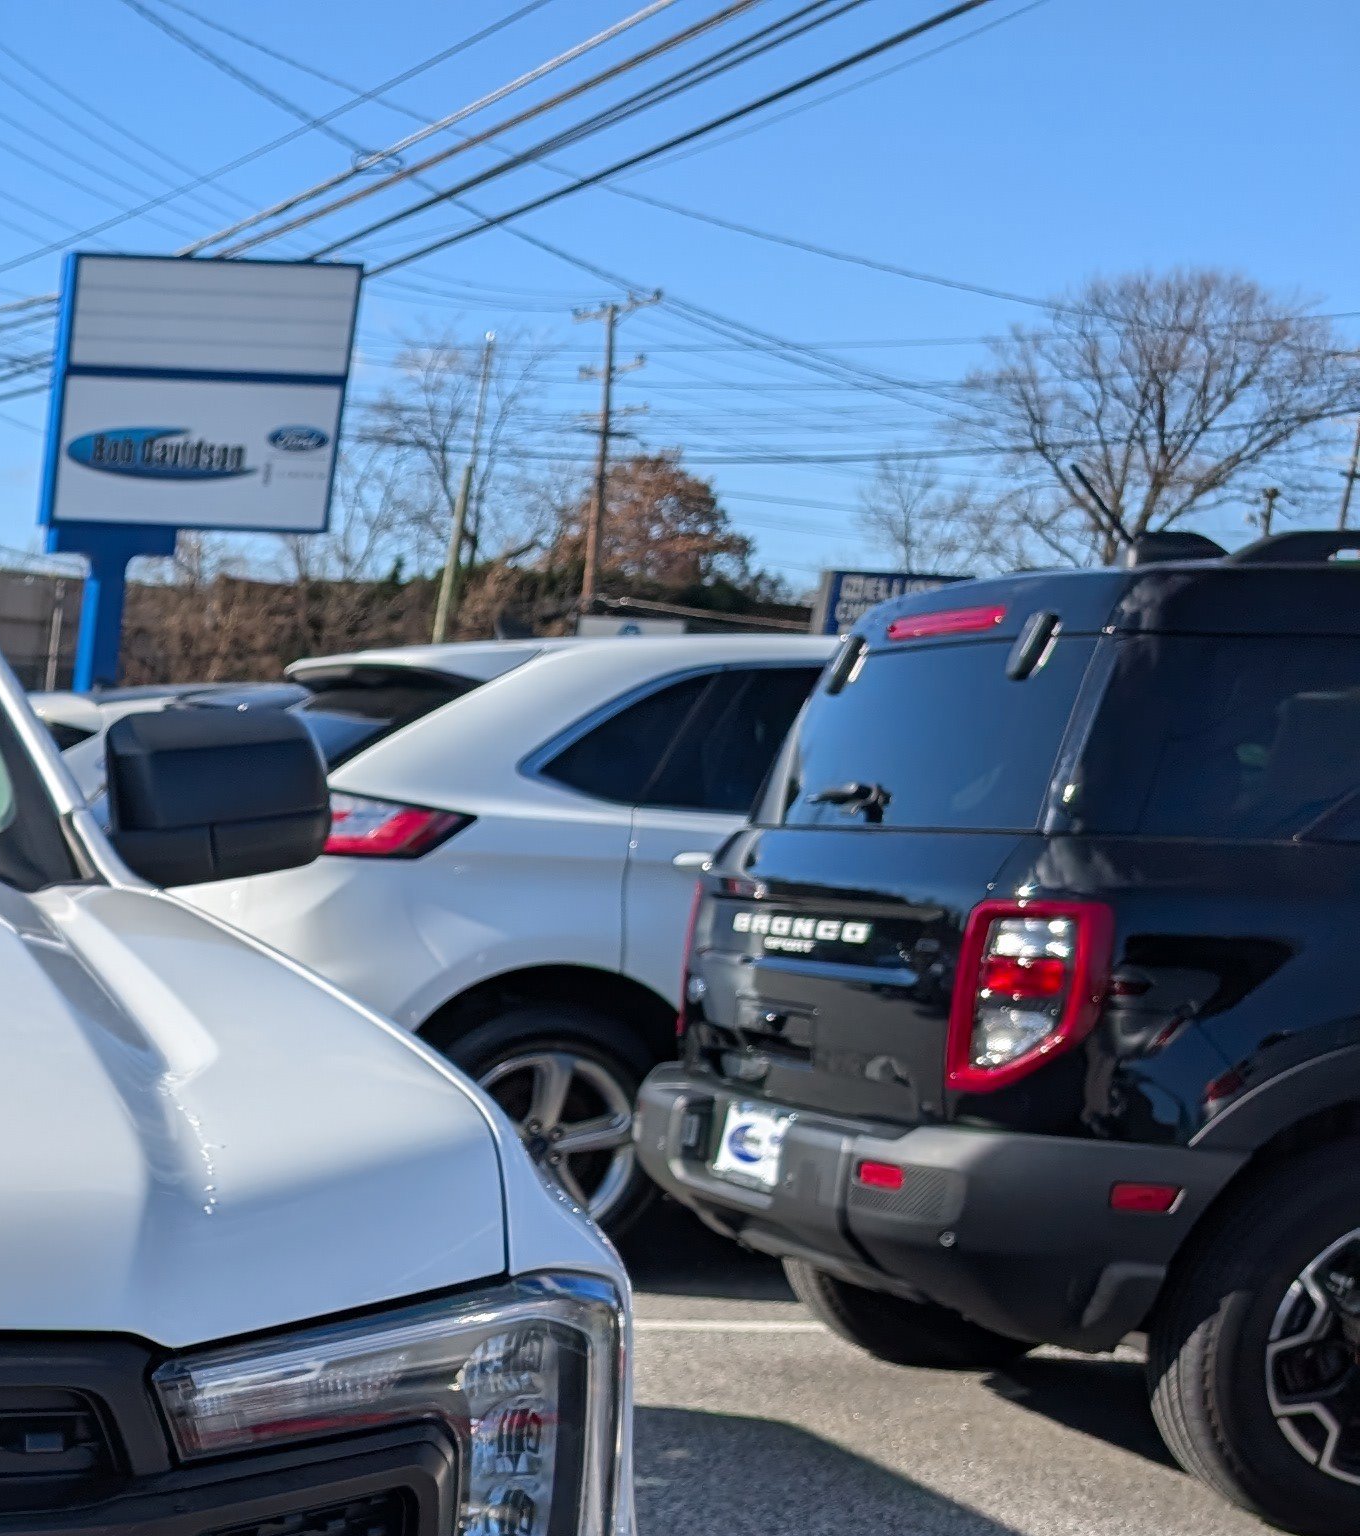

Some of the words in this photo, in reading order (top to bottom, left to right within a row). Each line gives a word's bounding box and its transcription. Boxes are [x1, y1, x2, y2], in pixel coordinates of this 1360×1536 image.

[91, 433, 135, 466] Bob
[141, 437, 246, 474] Davidson
[733, 912, 872, 944] BRONCO
